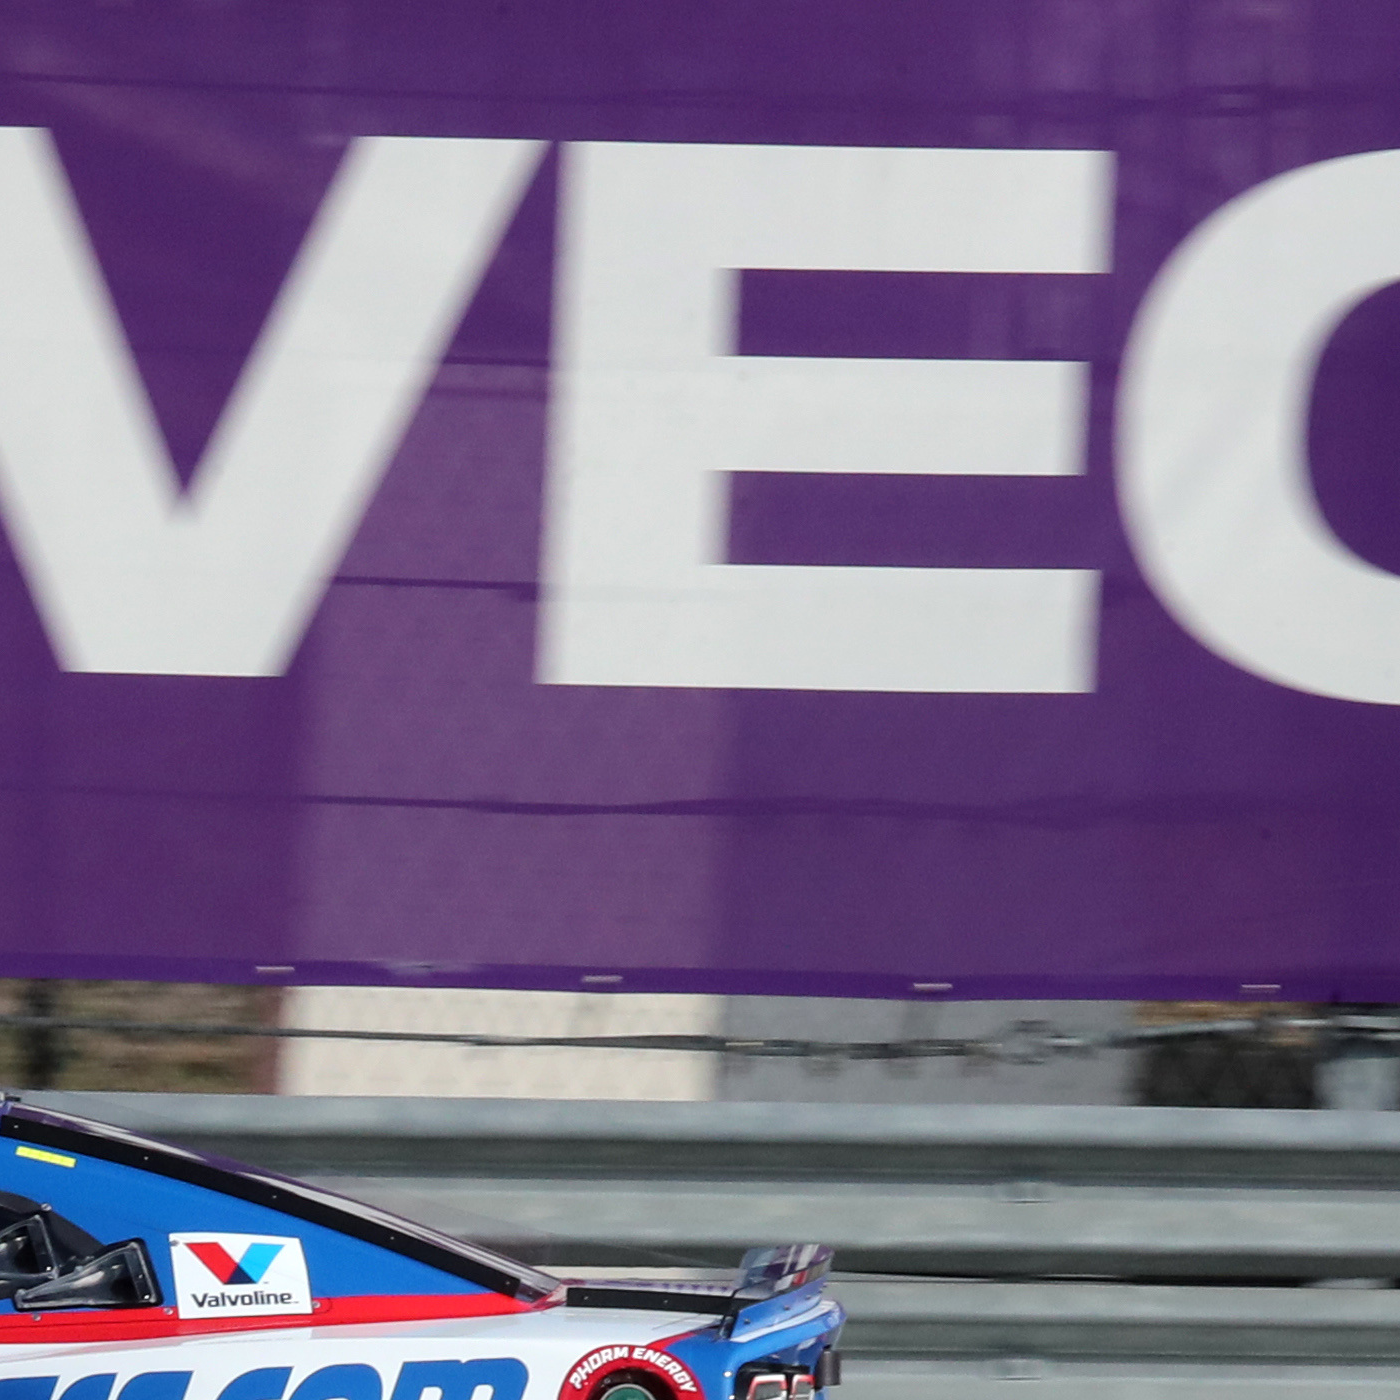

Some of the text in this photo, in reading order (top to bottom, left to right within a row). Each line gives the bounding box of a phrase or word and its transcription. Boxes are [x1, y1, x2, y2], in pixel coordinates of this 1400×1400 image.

[191, 1291, 293, 1308] Valvoline
[568, 1346, 698, 1392] PHORM ENERGY
